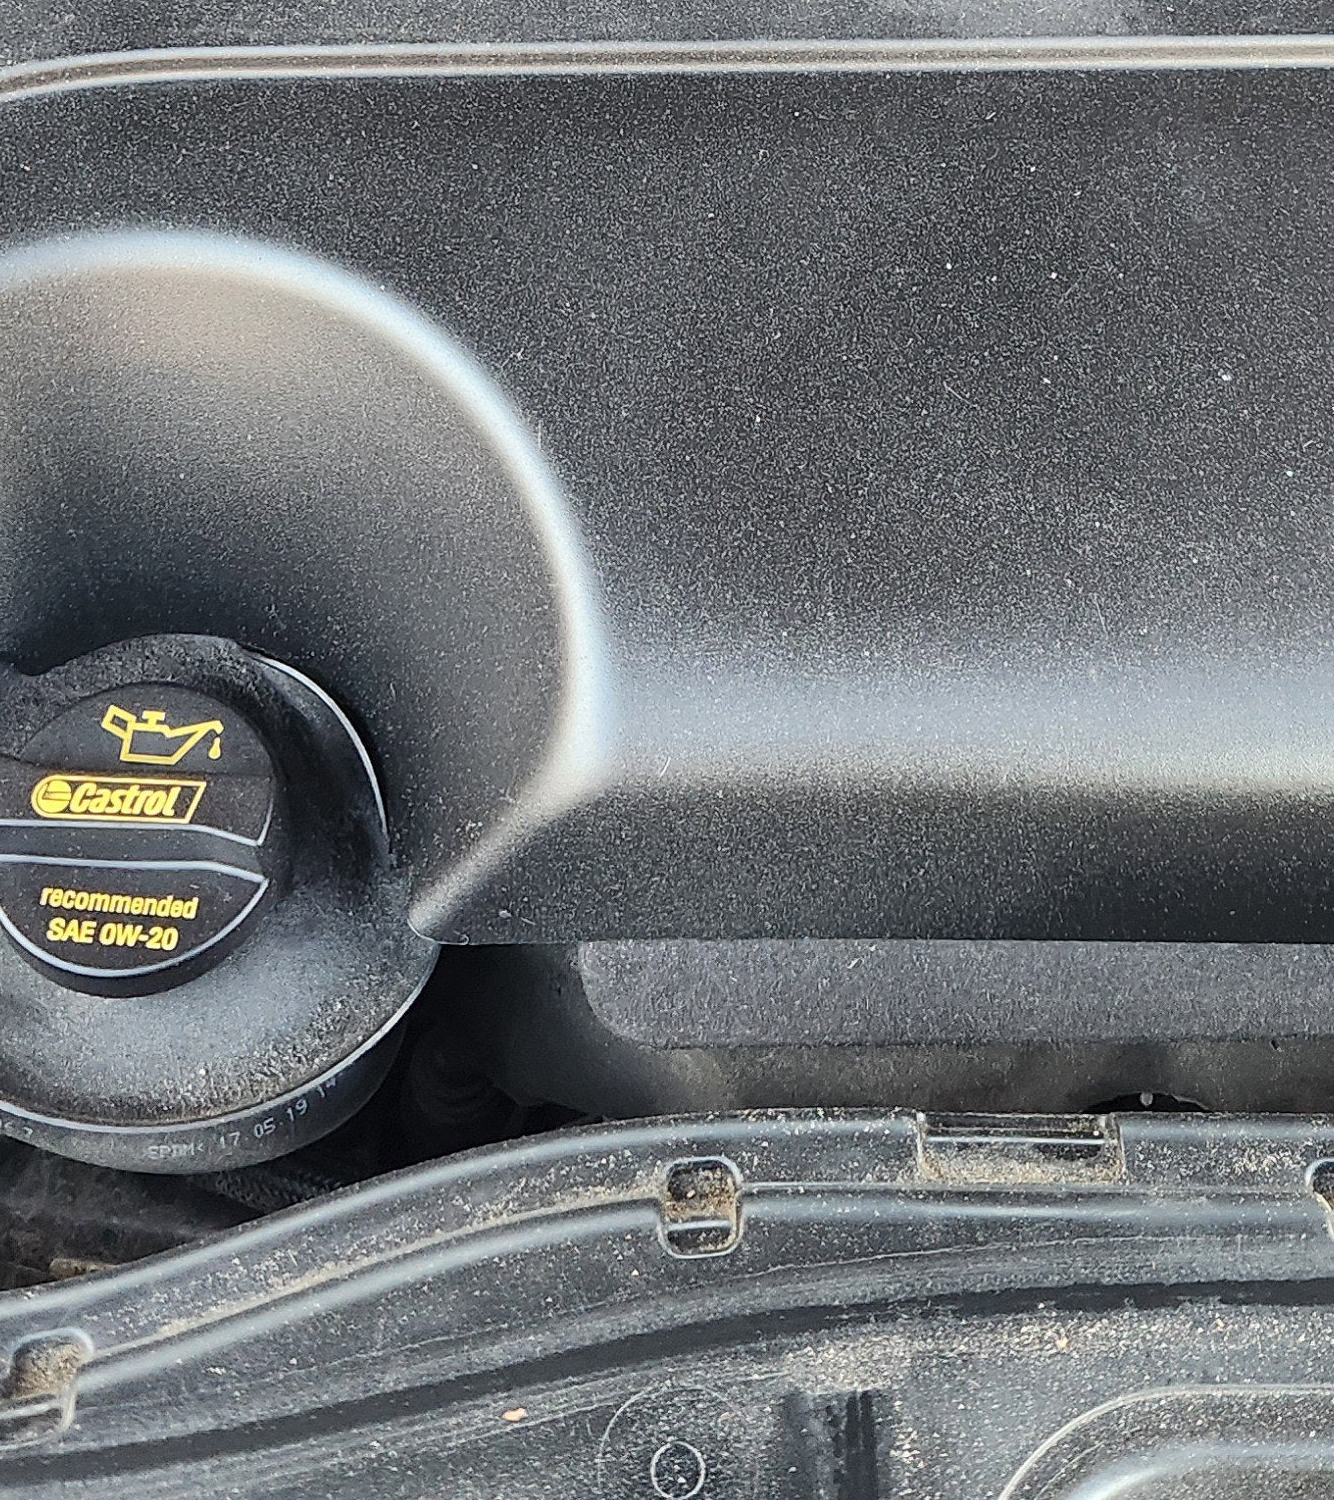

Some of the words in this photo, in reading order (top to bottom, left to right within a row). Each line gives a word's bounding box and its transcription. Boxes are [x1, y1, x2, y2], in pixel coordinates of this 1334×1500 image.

[69, 782, 182, 817] Castrol
[39, 886, 200, 920] recommended
[46, 916, 98, 944] SAE
[98, 922, 179, 951] 0W-20
